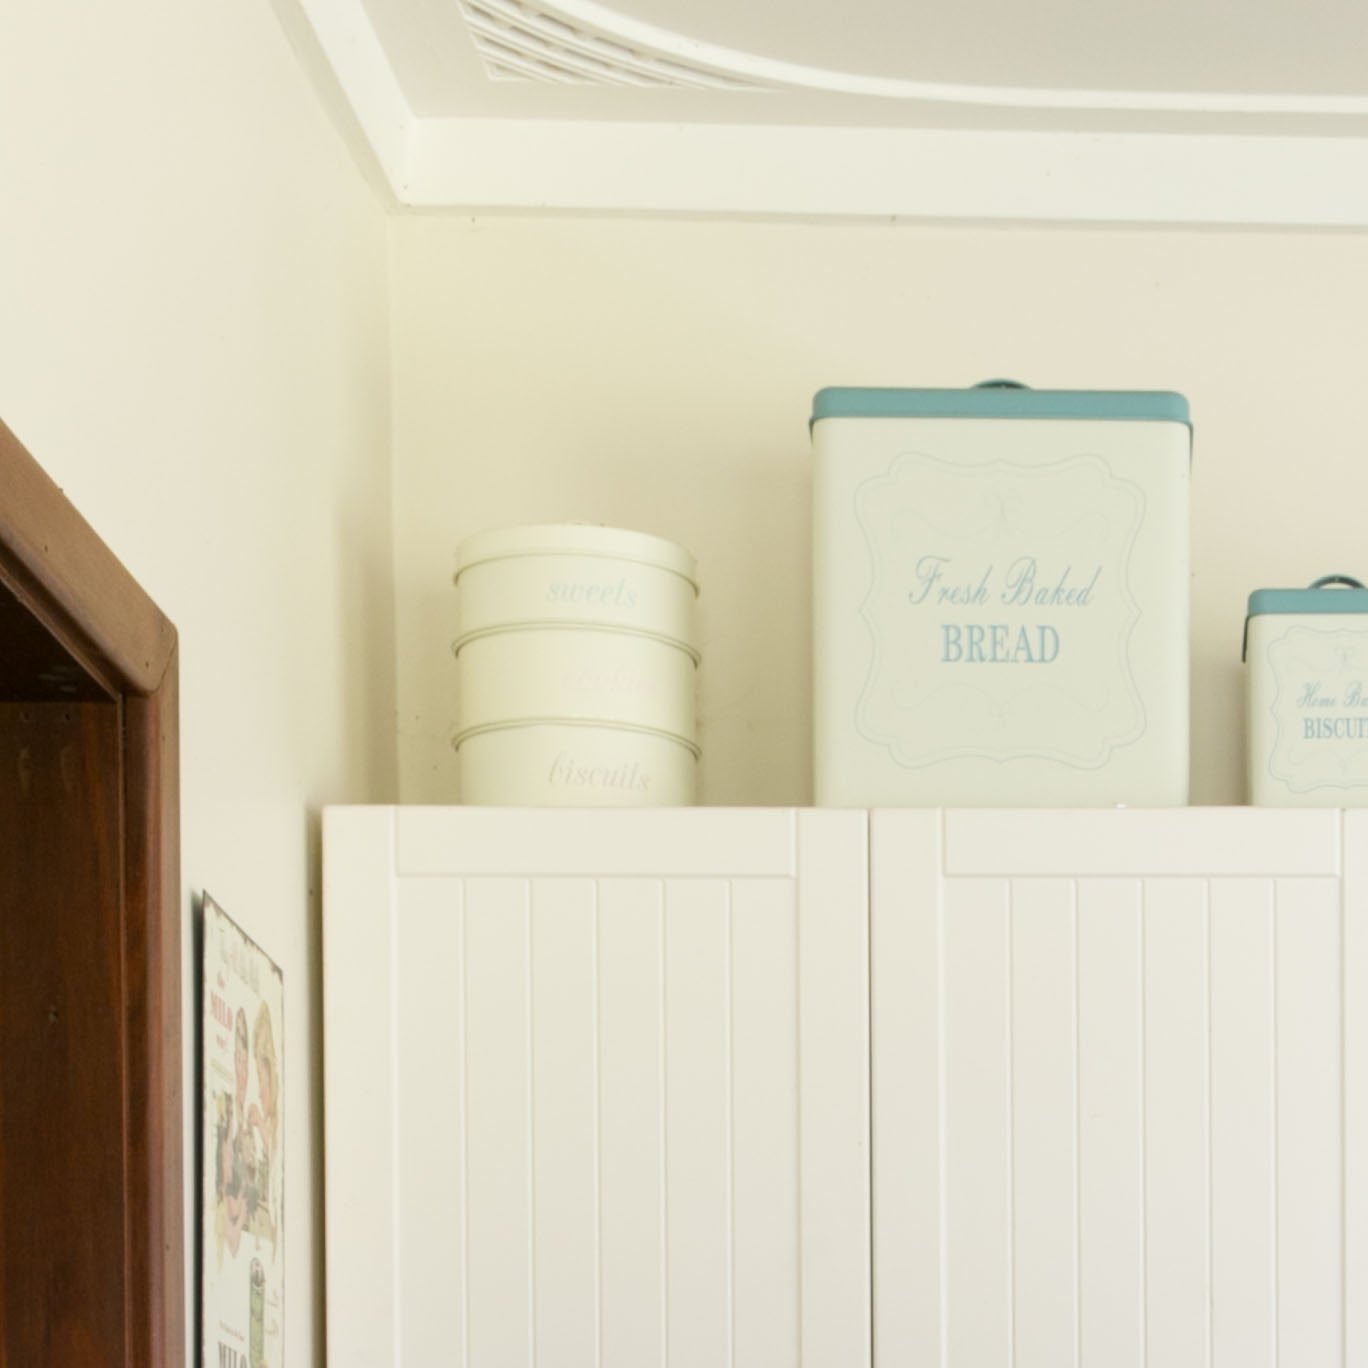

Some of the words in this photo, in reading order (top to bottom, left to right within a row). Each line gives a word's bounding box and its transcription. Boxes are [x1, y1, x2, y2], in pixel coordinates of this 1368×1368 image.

[545, 577, 639, 608] sweets
[907, 553, 994, 606] Fresh
[1000, 555, 1102, 607] Baked
[940, 623, 1061, 664] BREAD
[1296, 680, 1338, 709] Home
[548, 748, 653, 793] biscuits
